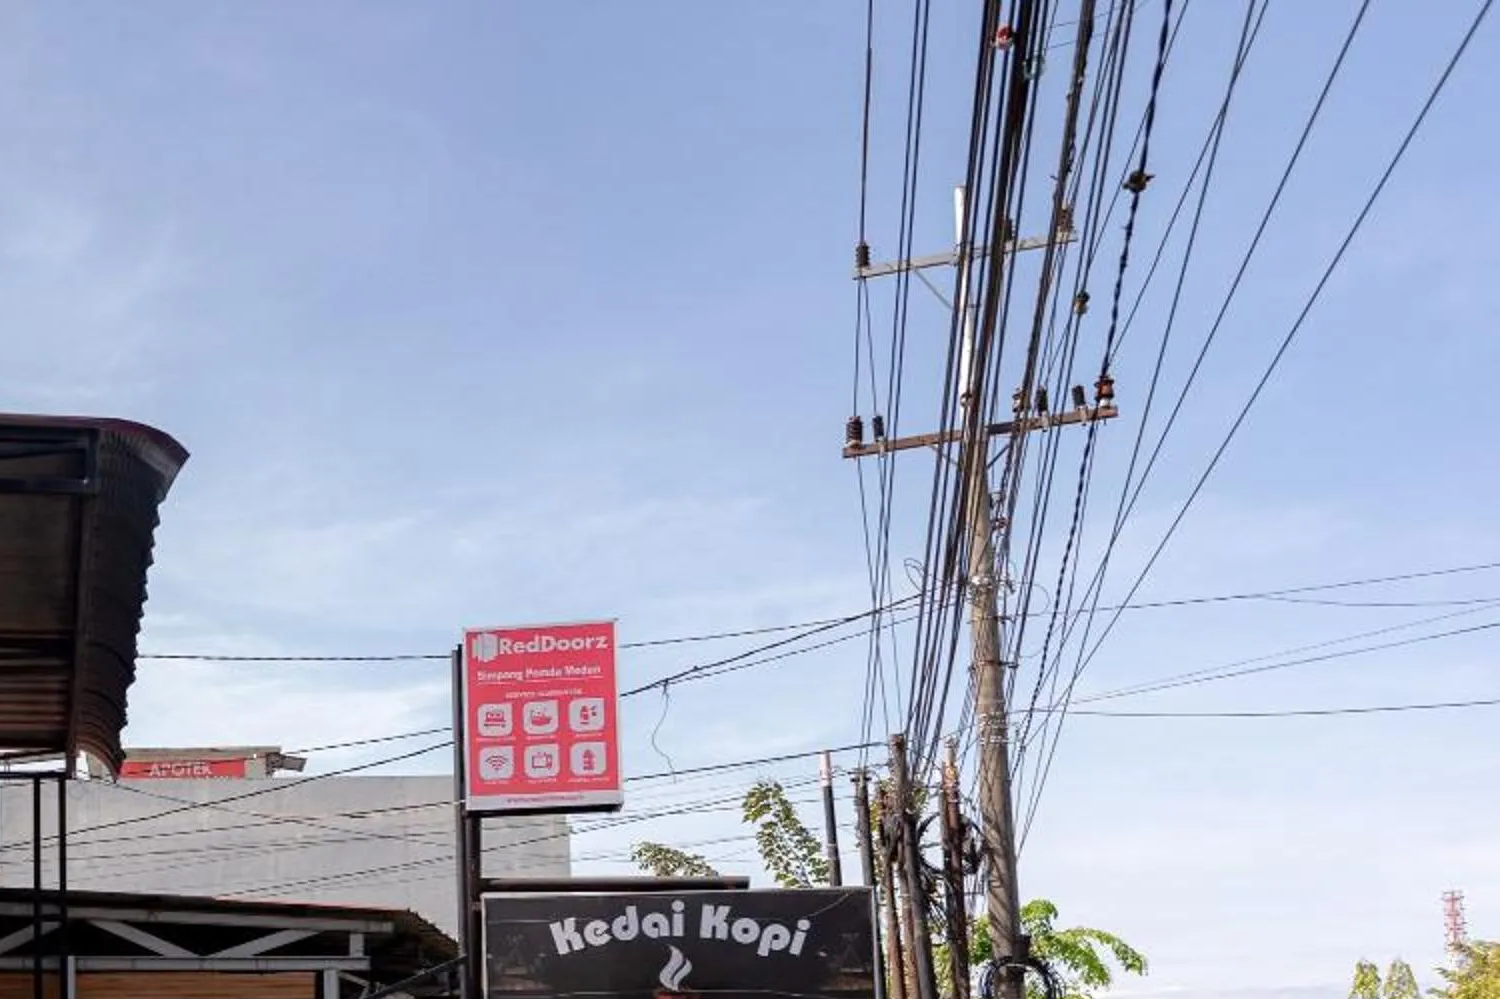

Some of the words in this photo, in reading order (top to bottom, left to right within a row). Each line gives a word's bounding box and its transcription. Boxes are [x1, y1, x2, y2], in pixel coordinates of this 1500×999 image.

[500, 634, 608, 655] RedDoorz
[149, 761, 212, 777] APOTEK
[549, 900, 685, 955] Kedai
[700, 903, 811, 957] Kopi
